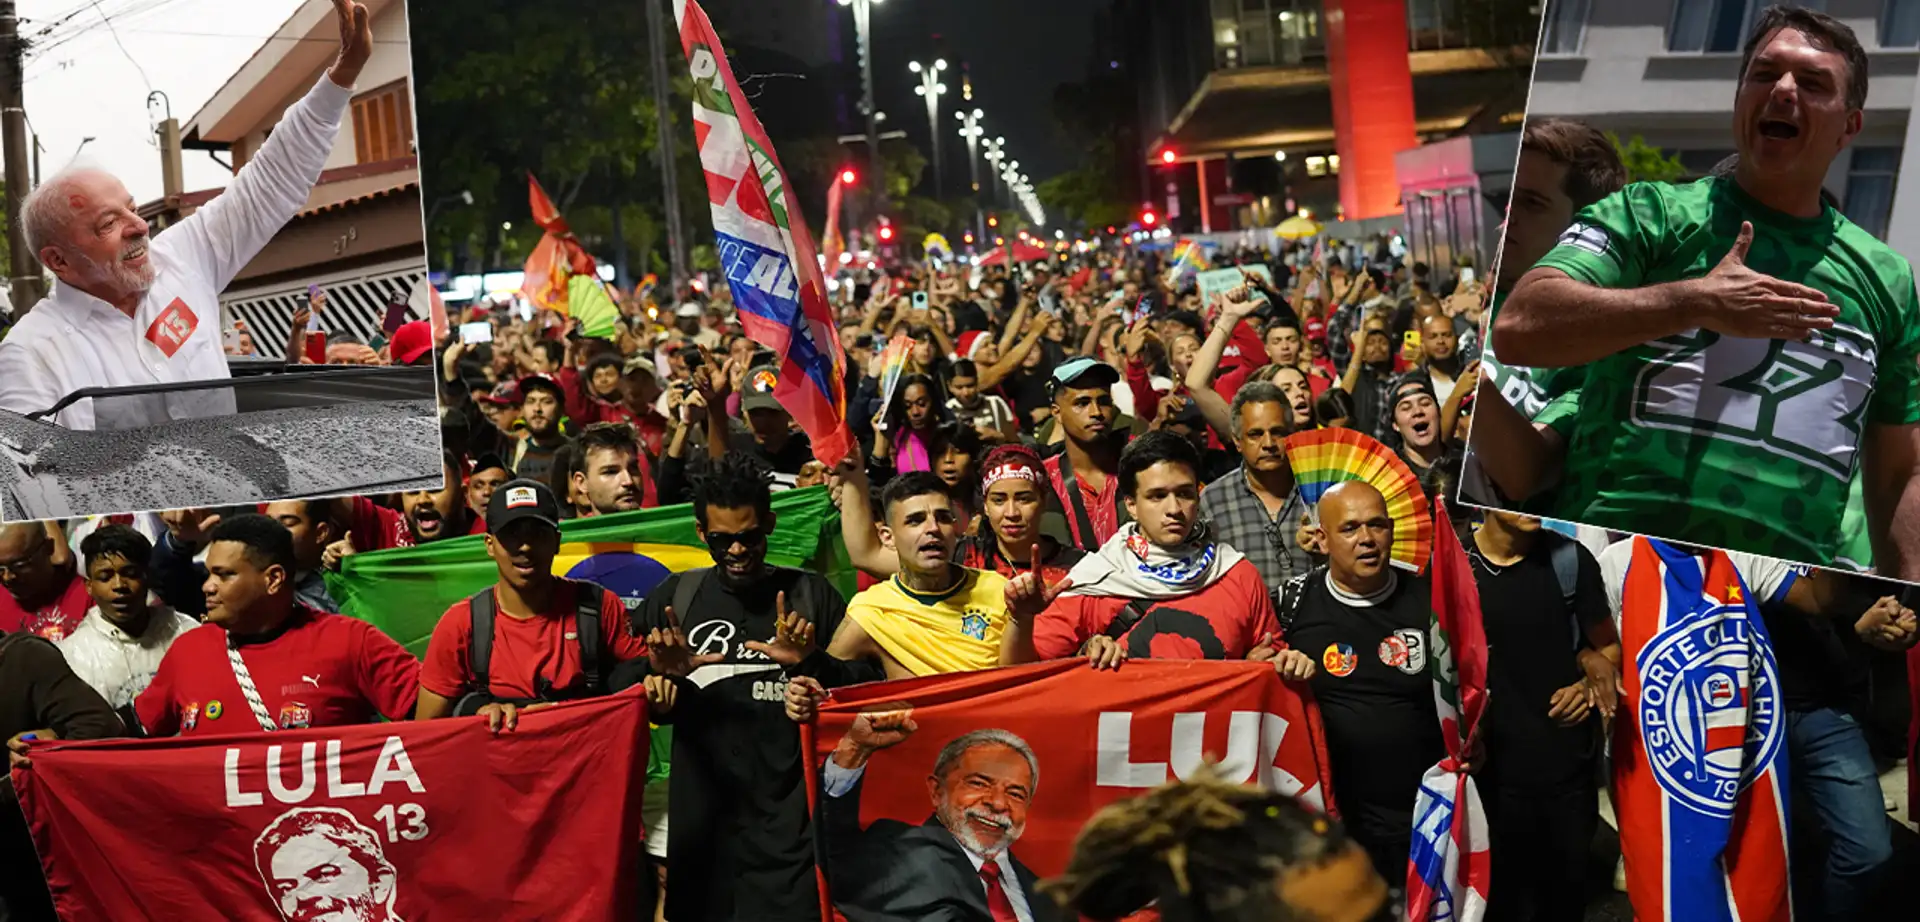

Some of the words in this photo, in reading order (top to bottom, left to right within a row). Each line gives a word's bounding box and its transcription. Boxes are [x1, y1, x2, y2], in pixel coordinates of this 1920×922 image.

[1643, 636, 1699, 769] ESPORTE
[1703, 620, 1749, 648] CLU
[224, 735, 427, 807] LULA
[1713, 779, 1739, 801] 19
[373, 802, 429, 843] 13
